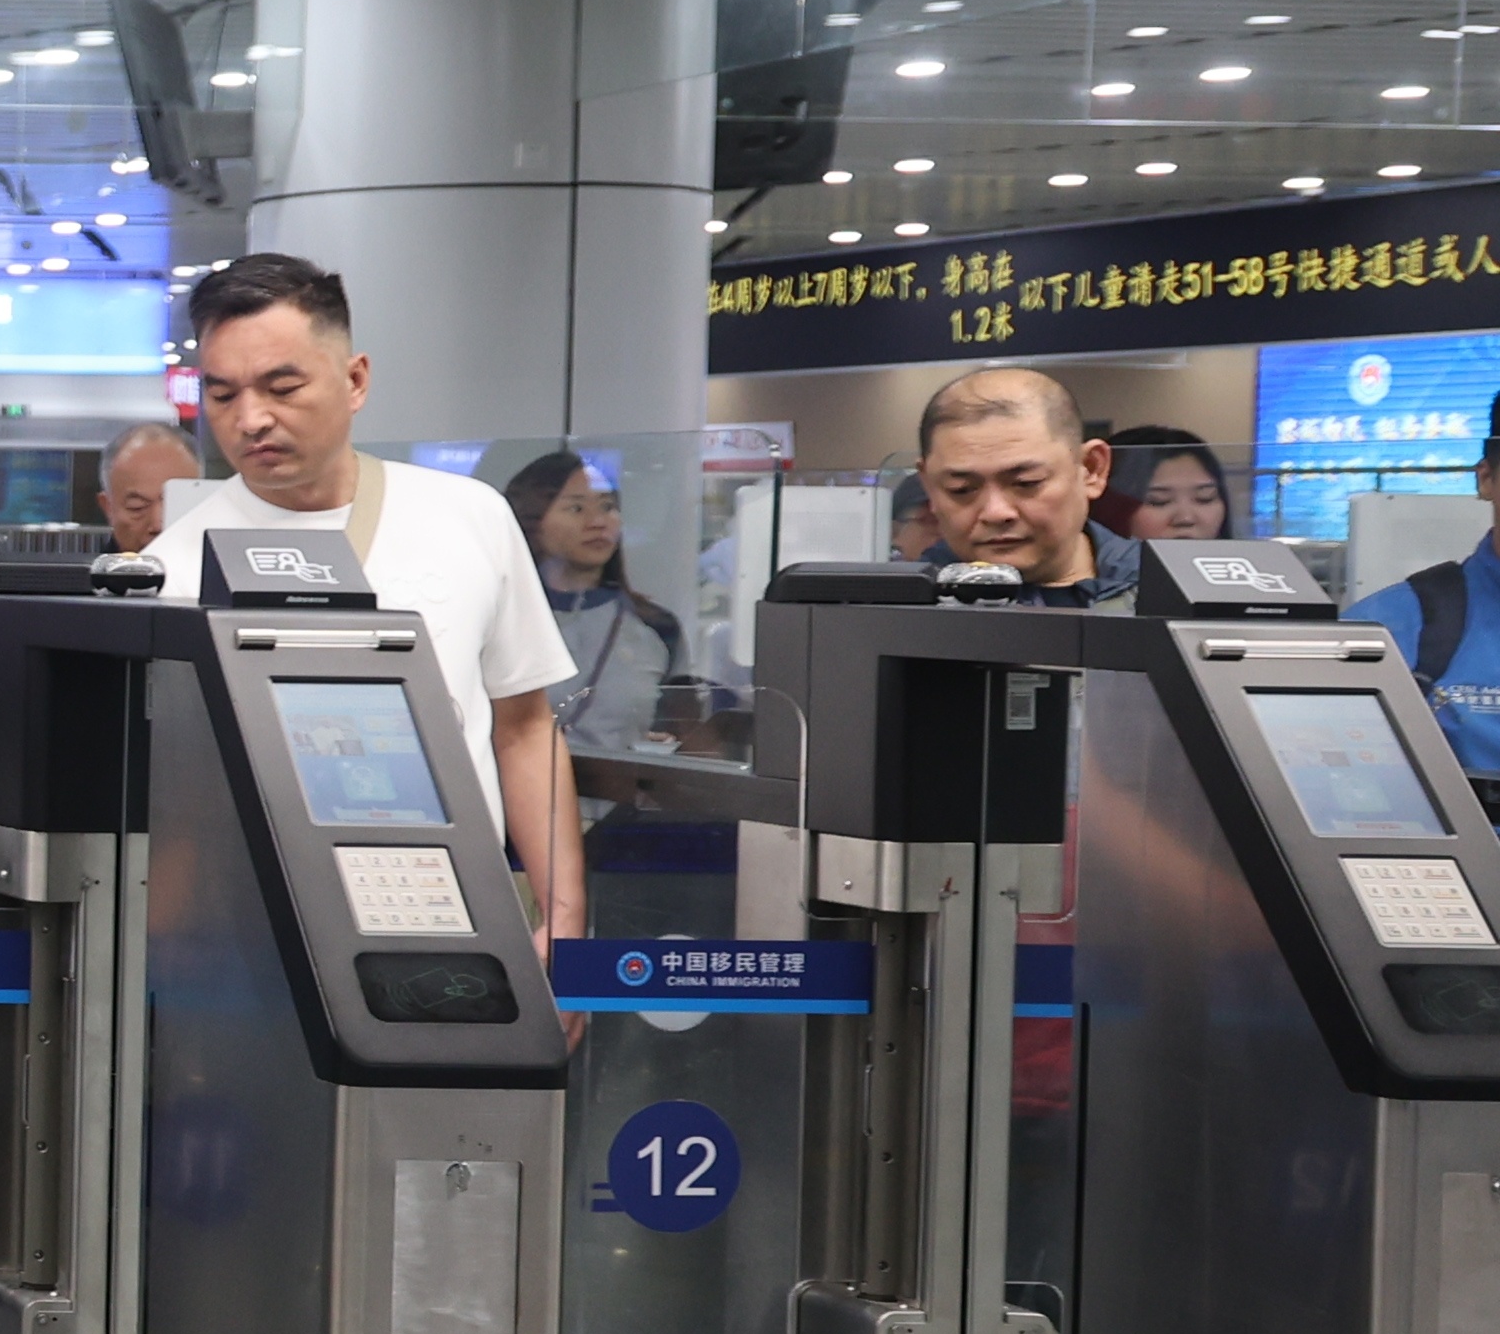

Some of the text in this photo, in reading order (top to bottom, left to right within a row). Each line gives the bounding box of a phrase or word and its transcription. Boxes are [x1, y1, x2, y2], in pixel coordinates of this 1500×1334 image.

[949, 301, 1015, 343] 1.2米
[661, 950, 805, 973] 中国移民管理
[666, 976, 801, 987] CHINA IMMIGRATION
[636, 1136, 717, 1196] 12
